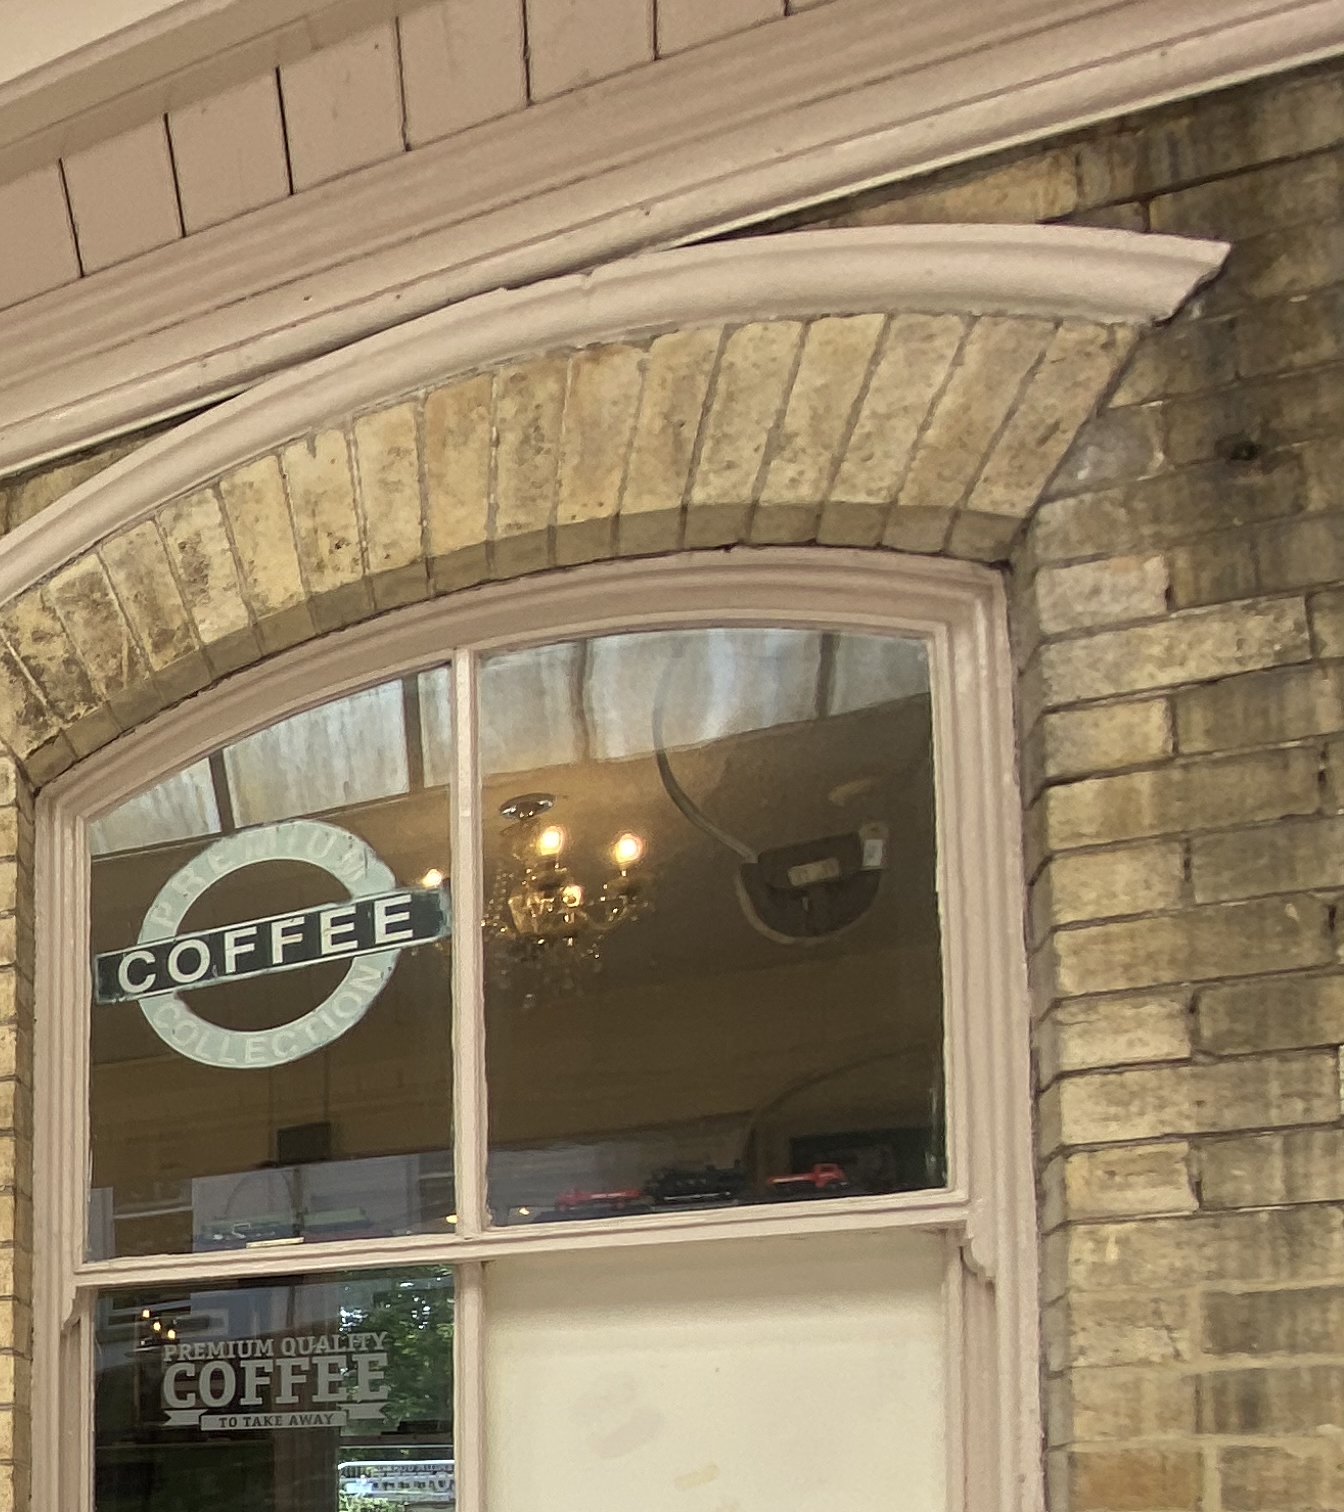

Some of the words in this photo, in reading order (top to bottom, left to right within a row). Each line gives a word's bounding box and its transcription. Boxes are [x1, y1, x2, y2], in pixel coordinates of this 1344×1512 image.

[153, 831, 370, 930] PREMIUM
[117, 893, 413, 995] COFFEE
[152, 965, 385, 1063] COLLECTION
[163, 1338, 275, 1363] PREMIUM
[280, 1331, 388, 1357] QUALITY
[163, 1352, 389, 1409] COFFEE
[219, 1416, 238, 1429] TO
[243, 1415, 283, 1428] TAKE
[288, 1413, 334, 1427] AWAY
